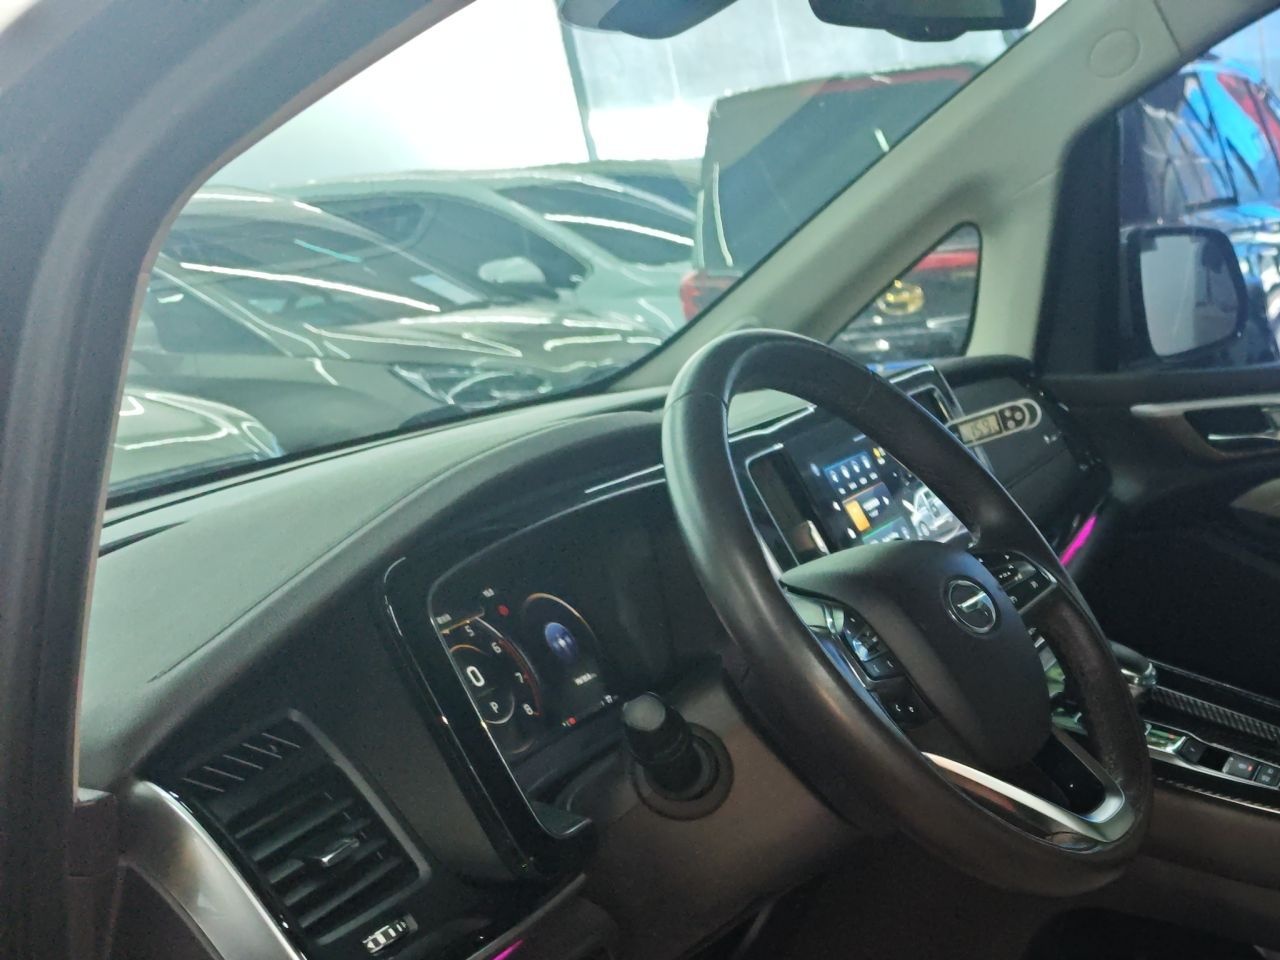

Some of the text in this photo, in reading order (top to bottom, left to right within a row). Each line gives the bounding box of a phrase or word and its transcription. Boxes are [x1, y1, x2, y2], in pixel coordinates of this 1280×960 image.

[491, 641, 503, 654] 6
[466, 665, 486, 688] 0
[489, 701, 500, 714] P
[522, 703, 535, 716] 8
